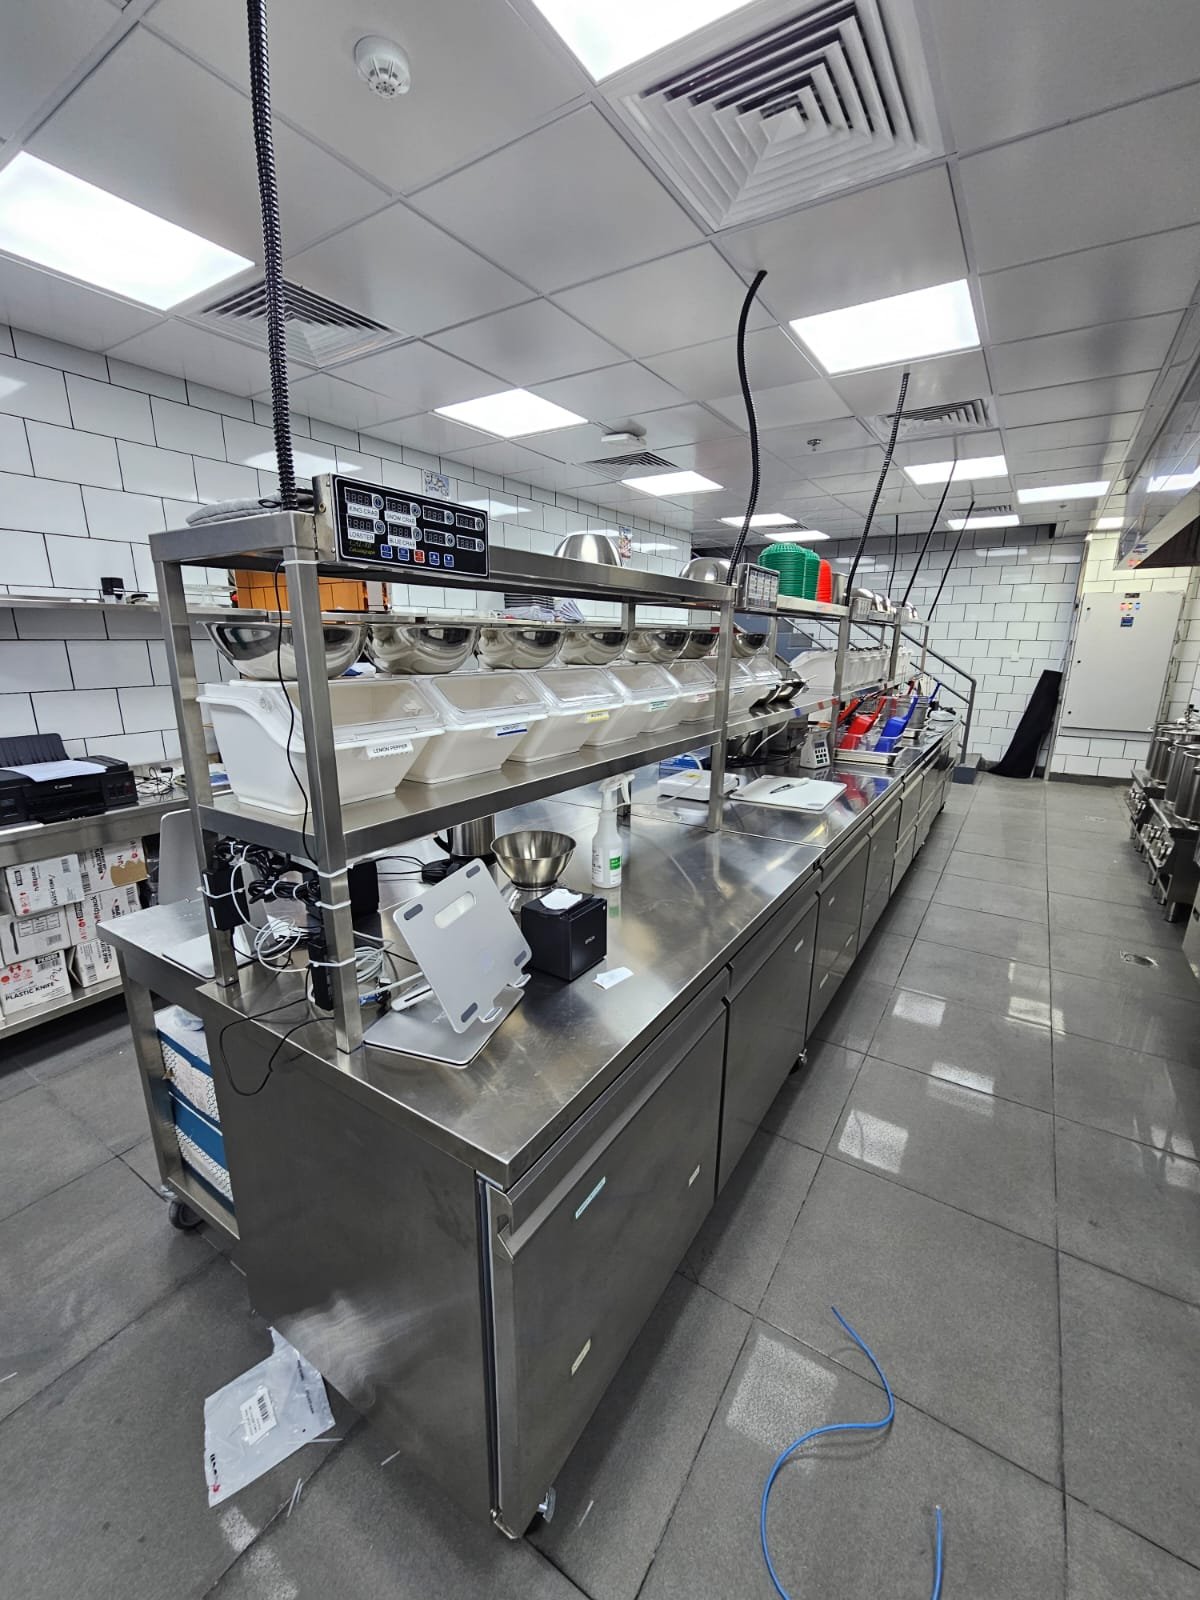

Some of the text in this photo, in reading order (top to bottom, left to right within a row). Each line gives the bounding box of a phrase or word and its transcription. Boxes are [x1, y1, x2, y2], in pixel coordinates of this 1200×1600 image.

[374, 746, 390, 754] LEMON
[5, 989, 34, 1000] PLASTIC
[35, 982, 54, 991] KNIFE
